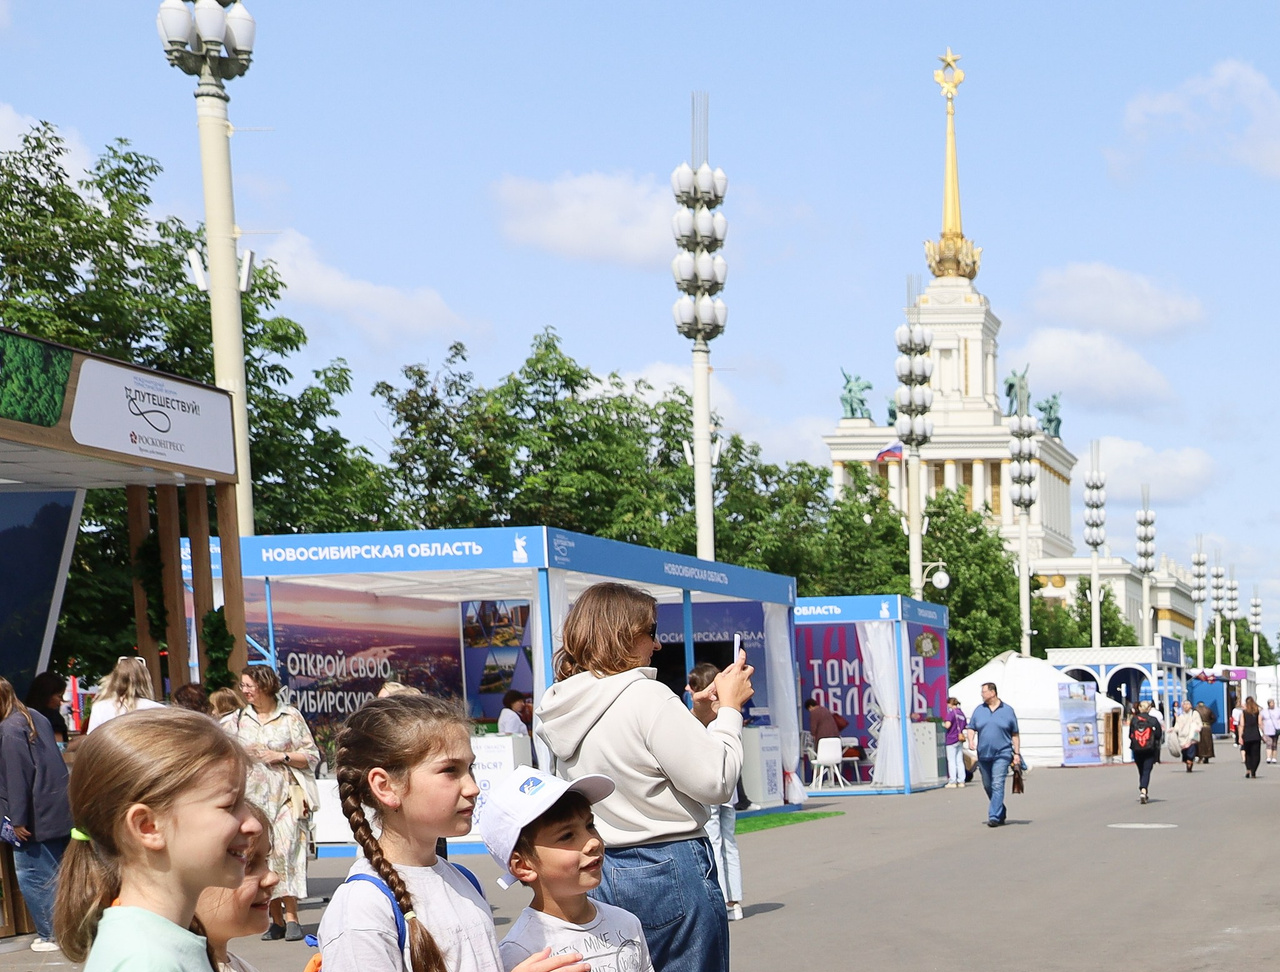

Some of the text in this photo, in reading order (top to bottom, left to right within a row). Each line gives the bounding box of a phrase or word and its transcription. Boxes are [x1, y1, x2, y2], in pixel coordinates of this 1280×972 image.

[261, 541, 483, 562] НОВОСИБИРСКАЯ ОБЛАСТЬ
[794, 605, 842, 616] ОБЛАСТЬ
[286, 649, 391, 679] ОТКРОЙ СВОЮ
[809, 656, 925, 687] ТОМЯ
[811, 686, 927, 716] ОБЛАЬ
